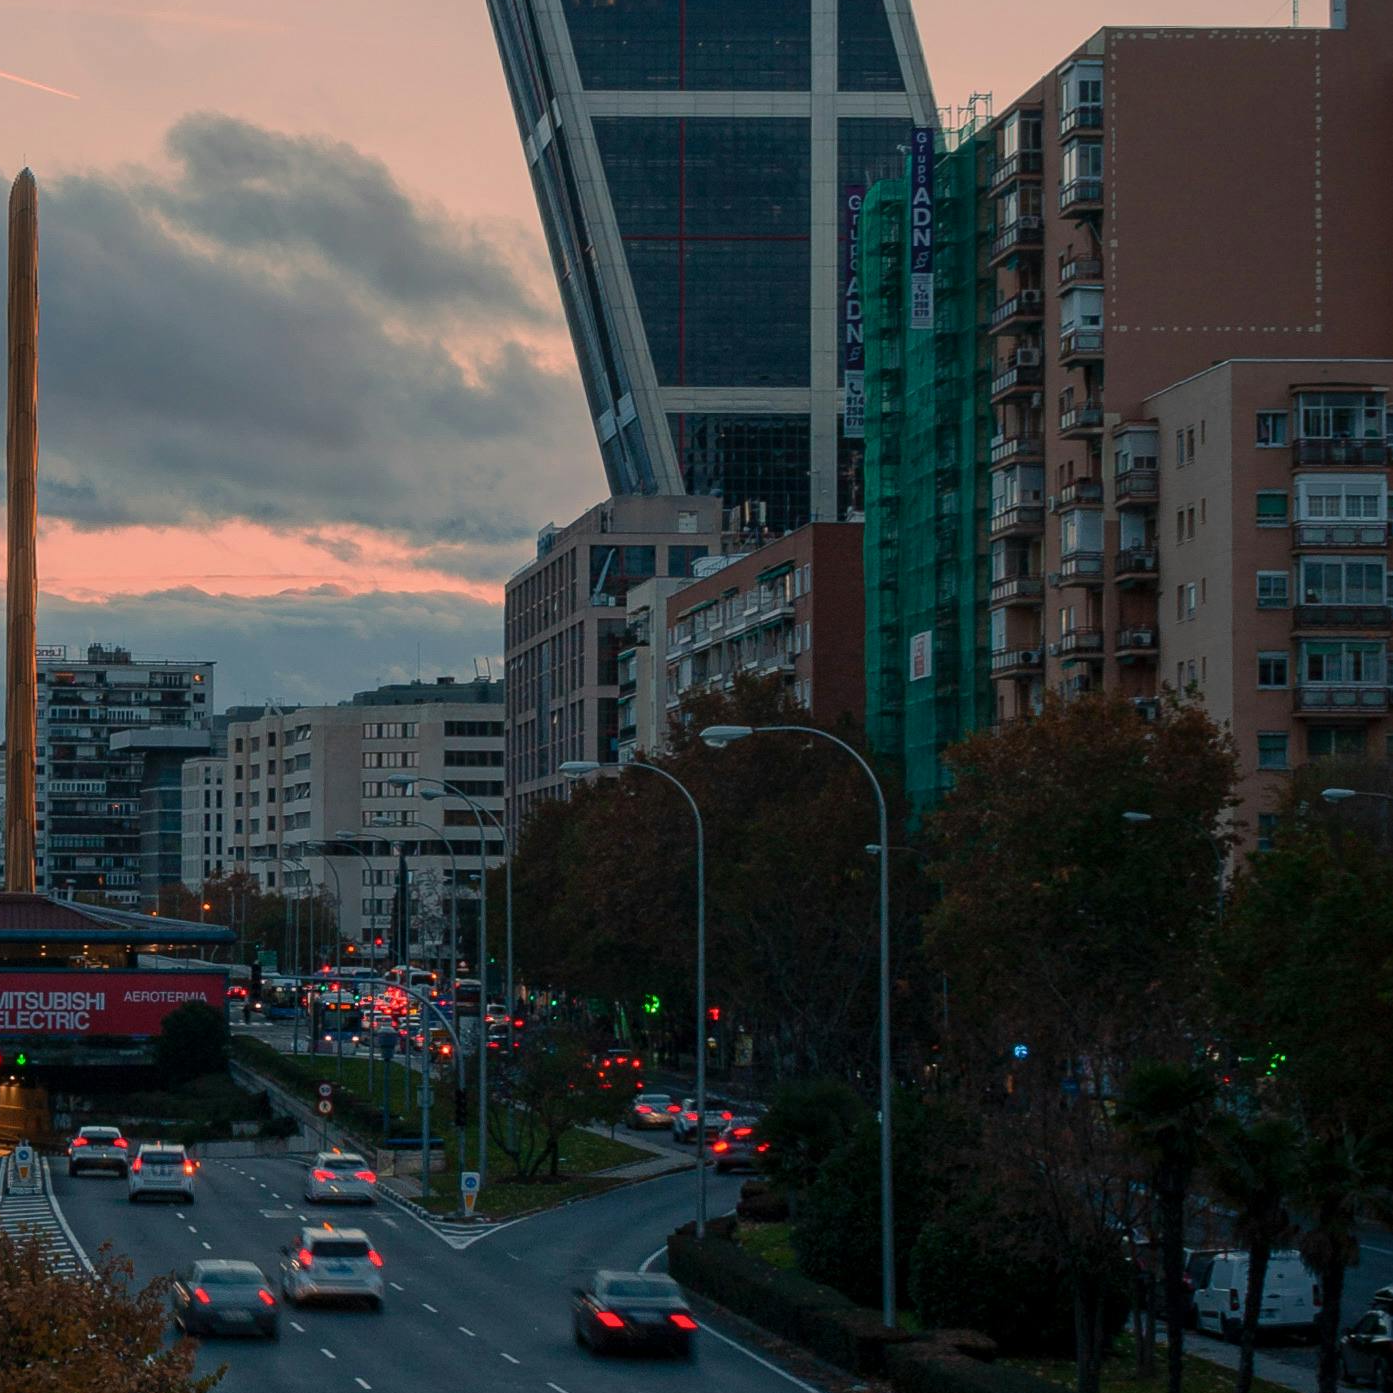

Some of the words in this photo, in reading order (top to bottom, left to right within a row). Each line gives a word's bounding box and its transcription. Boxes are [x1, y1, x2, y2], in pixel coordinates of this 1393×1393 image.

[916, 132, 928, 184] Grupo
[913, 187, 931, 246] ADN
[846, 276, 863, 343] ADN
[123, 991, 208, 1003] AEROTERMIA
